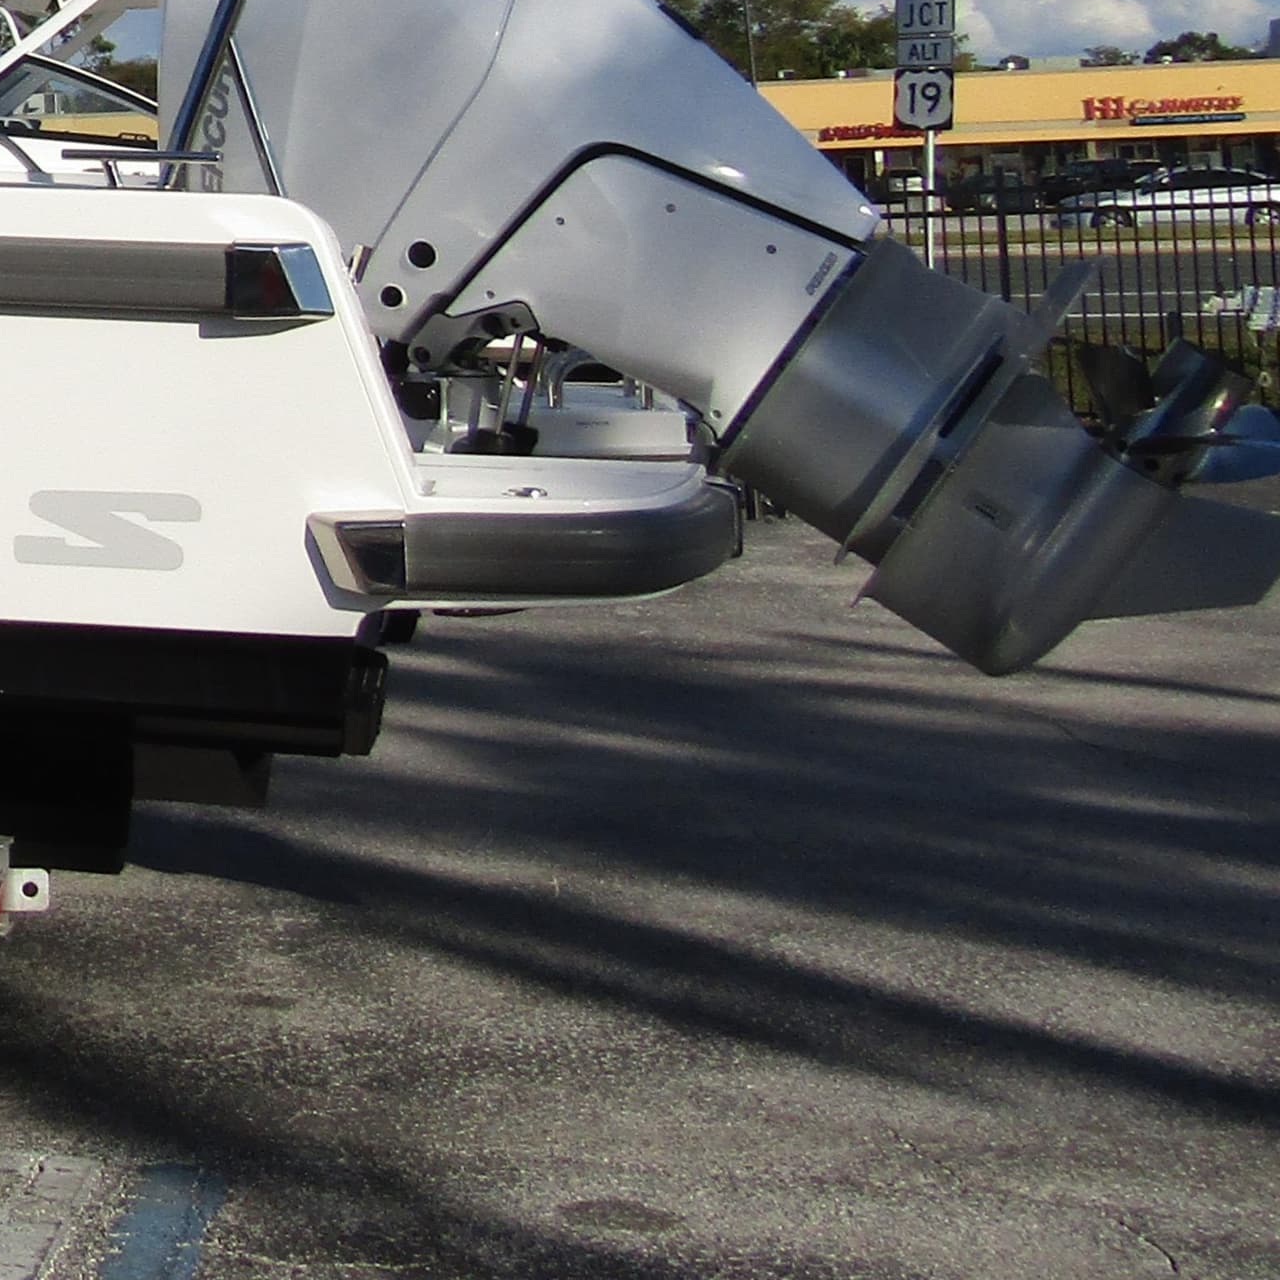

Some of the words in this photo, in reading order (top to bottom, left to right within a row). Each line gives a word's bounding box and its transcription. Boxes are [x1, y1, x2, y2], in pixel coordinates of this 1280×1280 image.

[903, 2, 947, 28] JCT
[908, 43, 941, 61] ALT
[908, 82, 941, 114] 19
